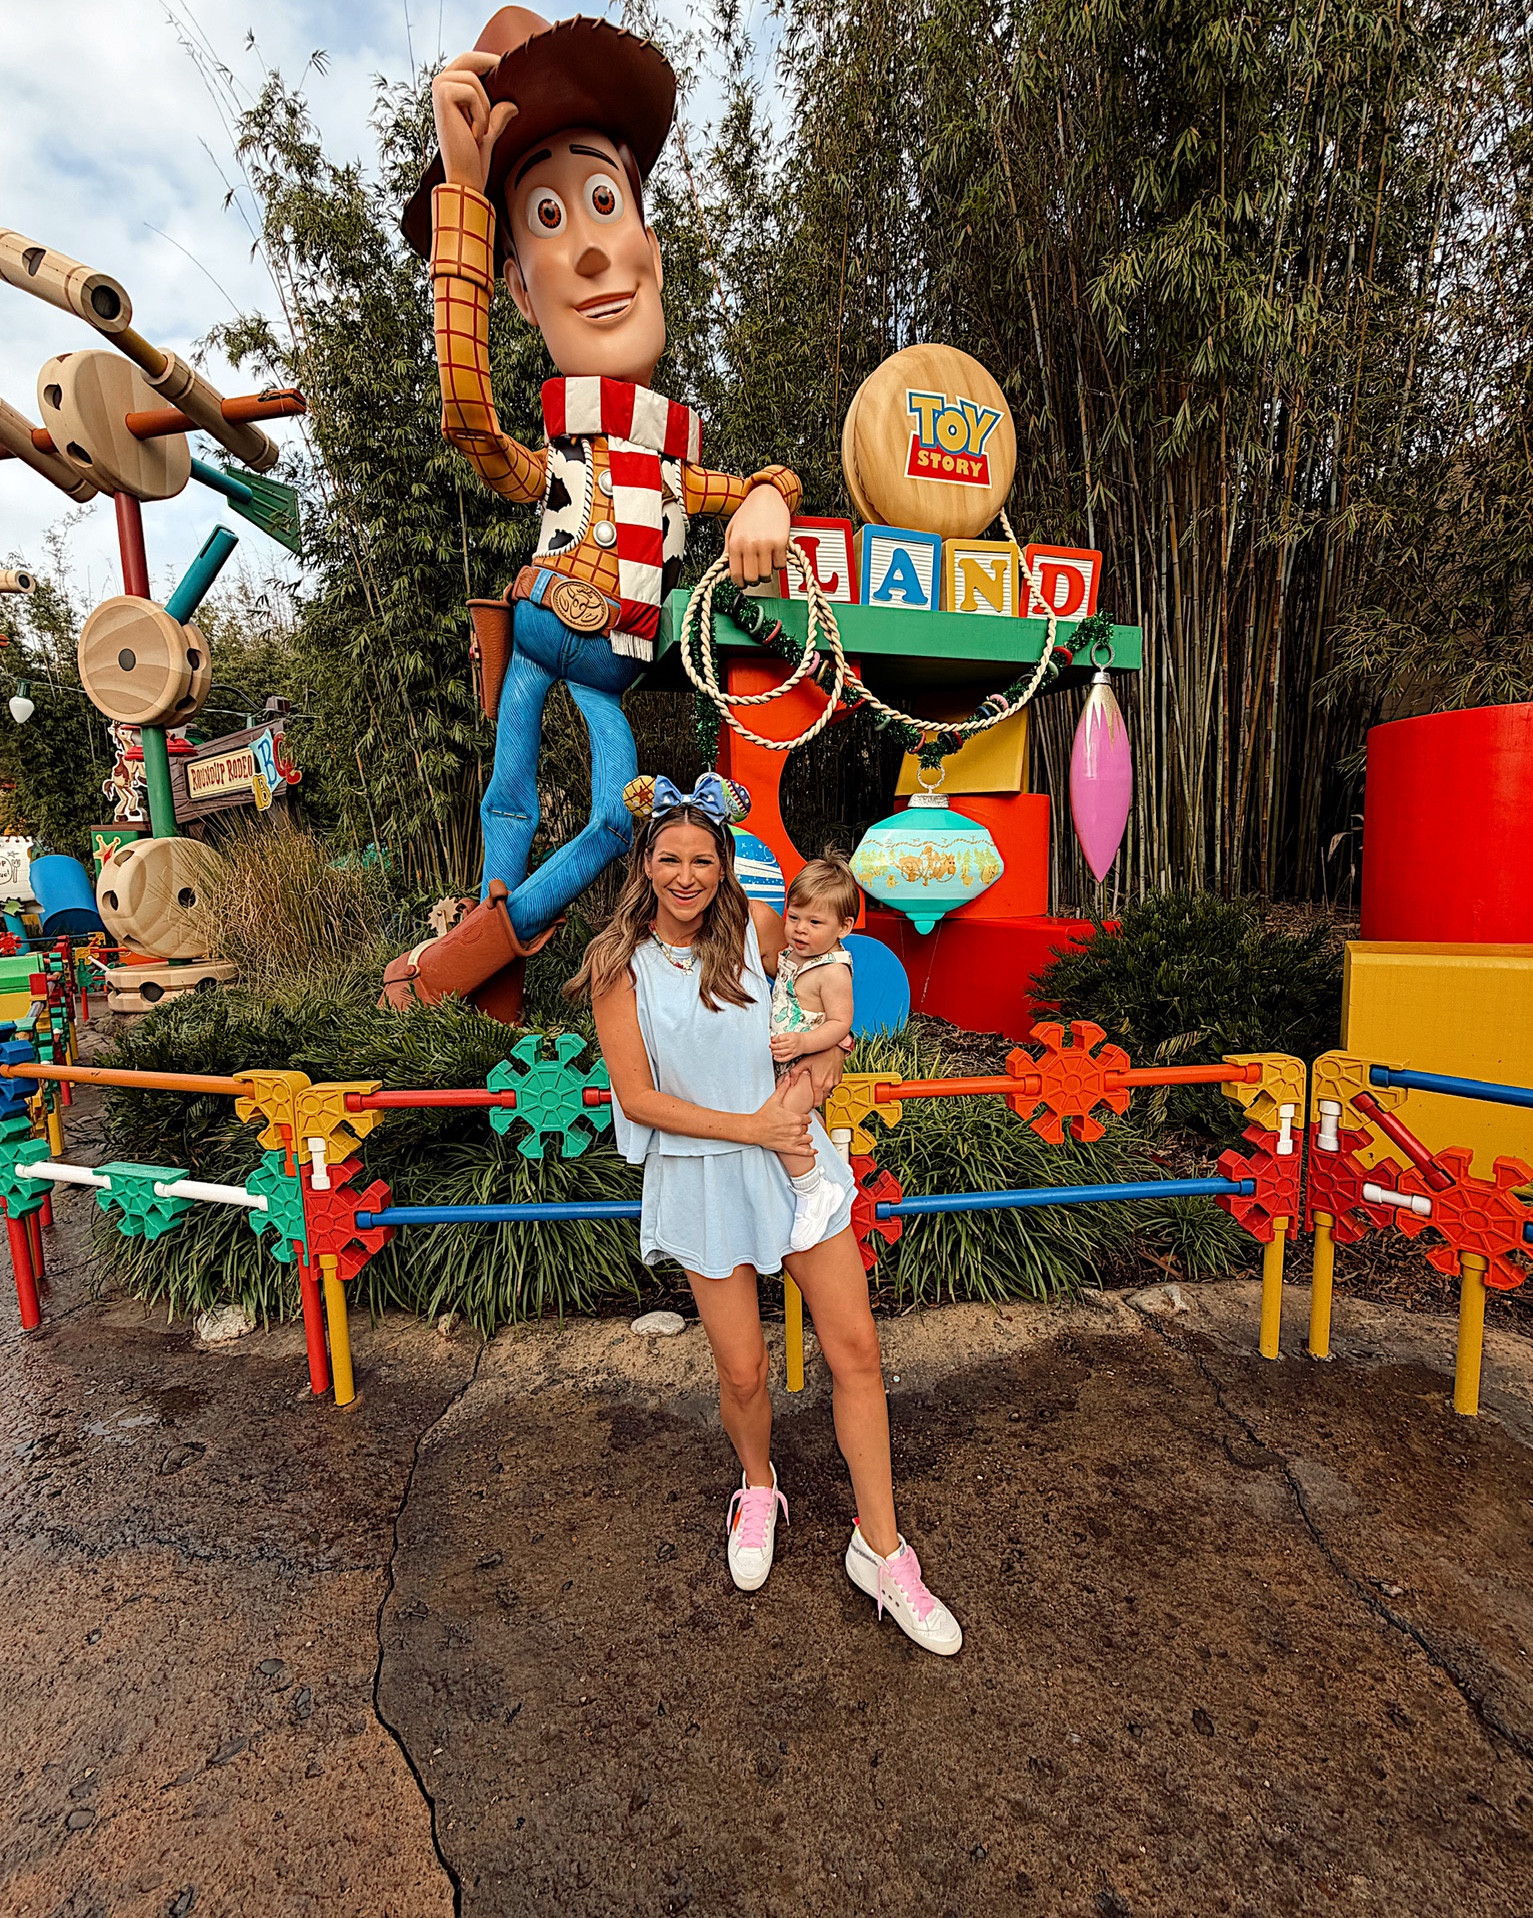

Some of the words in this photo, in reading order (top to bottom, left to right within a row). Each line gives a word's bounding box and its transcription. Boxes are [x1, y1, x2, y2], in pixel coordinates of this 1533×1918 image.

[908, 391, 1001, 458] TOY
[917, 450, 983, 477] STORY
[793, 535, 1085, 617] LAND
[190, 762, 225, 791] ROUNDUP
[226, 755, 253, 782] RODEO
